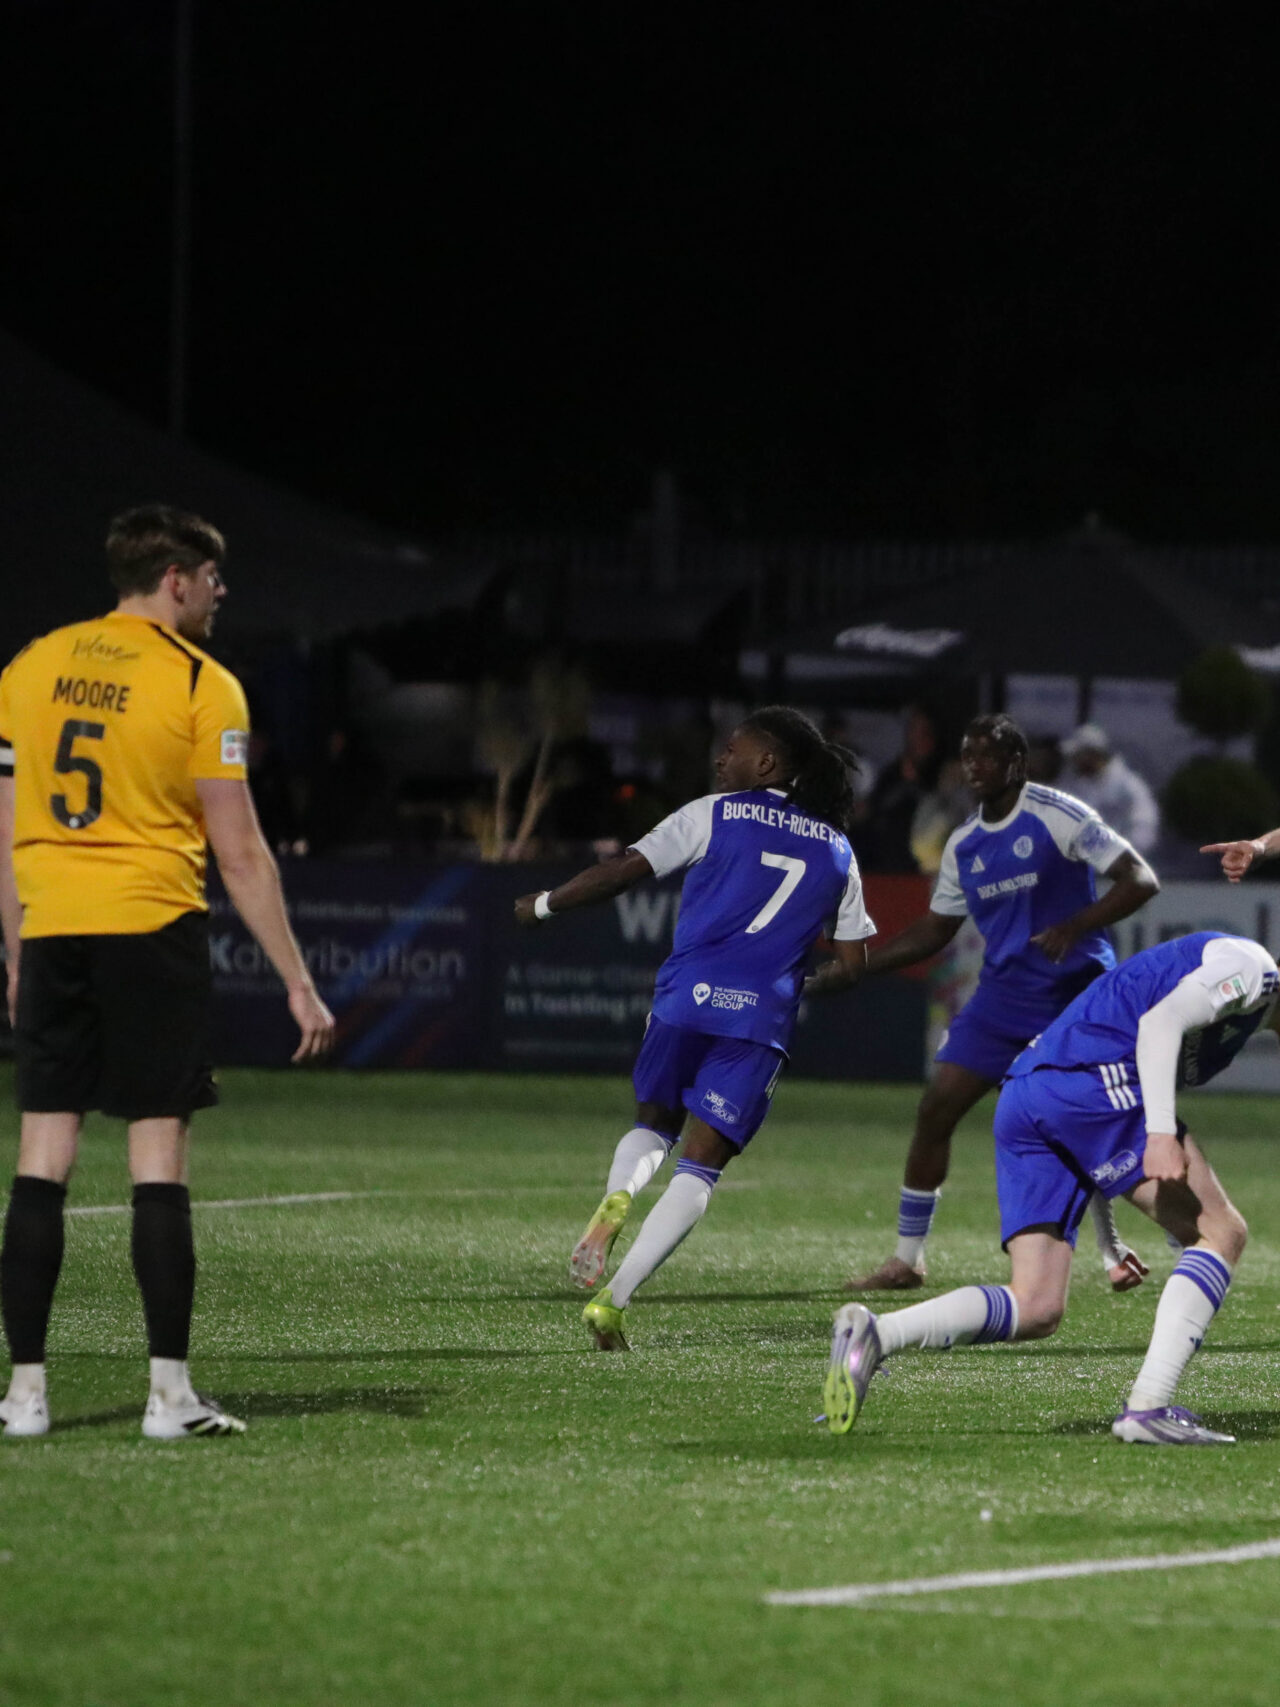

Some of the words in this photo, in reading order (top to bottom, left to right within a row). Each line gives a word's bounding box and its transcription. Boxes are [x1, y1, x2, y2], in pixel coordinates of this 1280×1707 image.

[53, 676, 130, 713] MOORE
[50, 718, 105, 829] 5
[744, 851, 807, 934] 7
[711, 999, 744, 1011] GROUP
[713, 991, 757, 1006] FOOTBALL
[712, 1105, 736, 1123] GROUP
